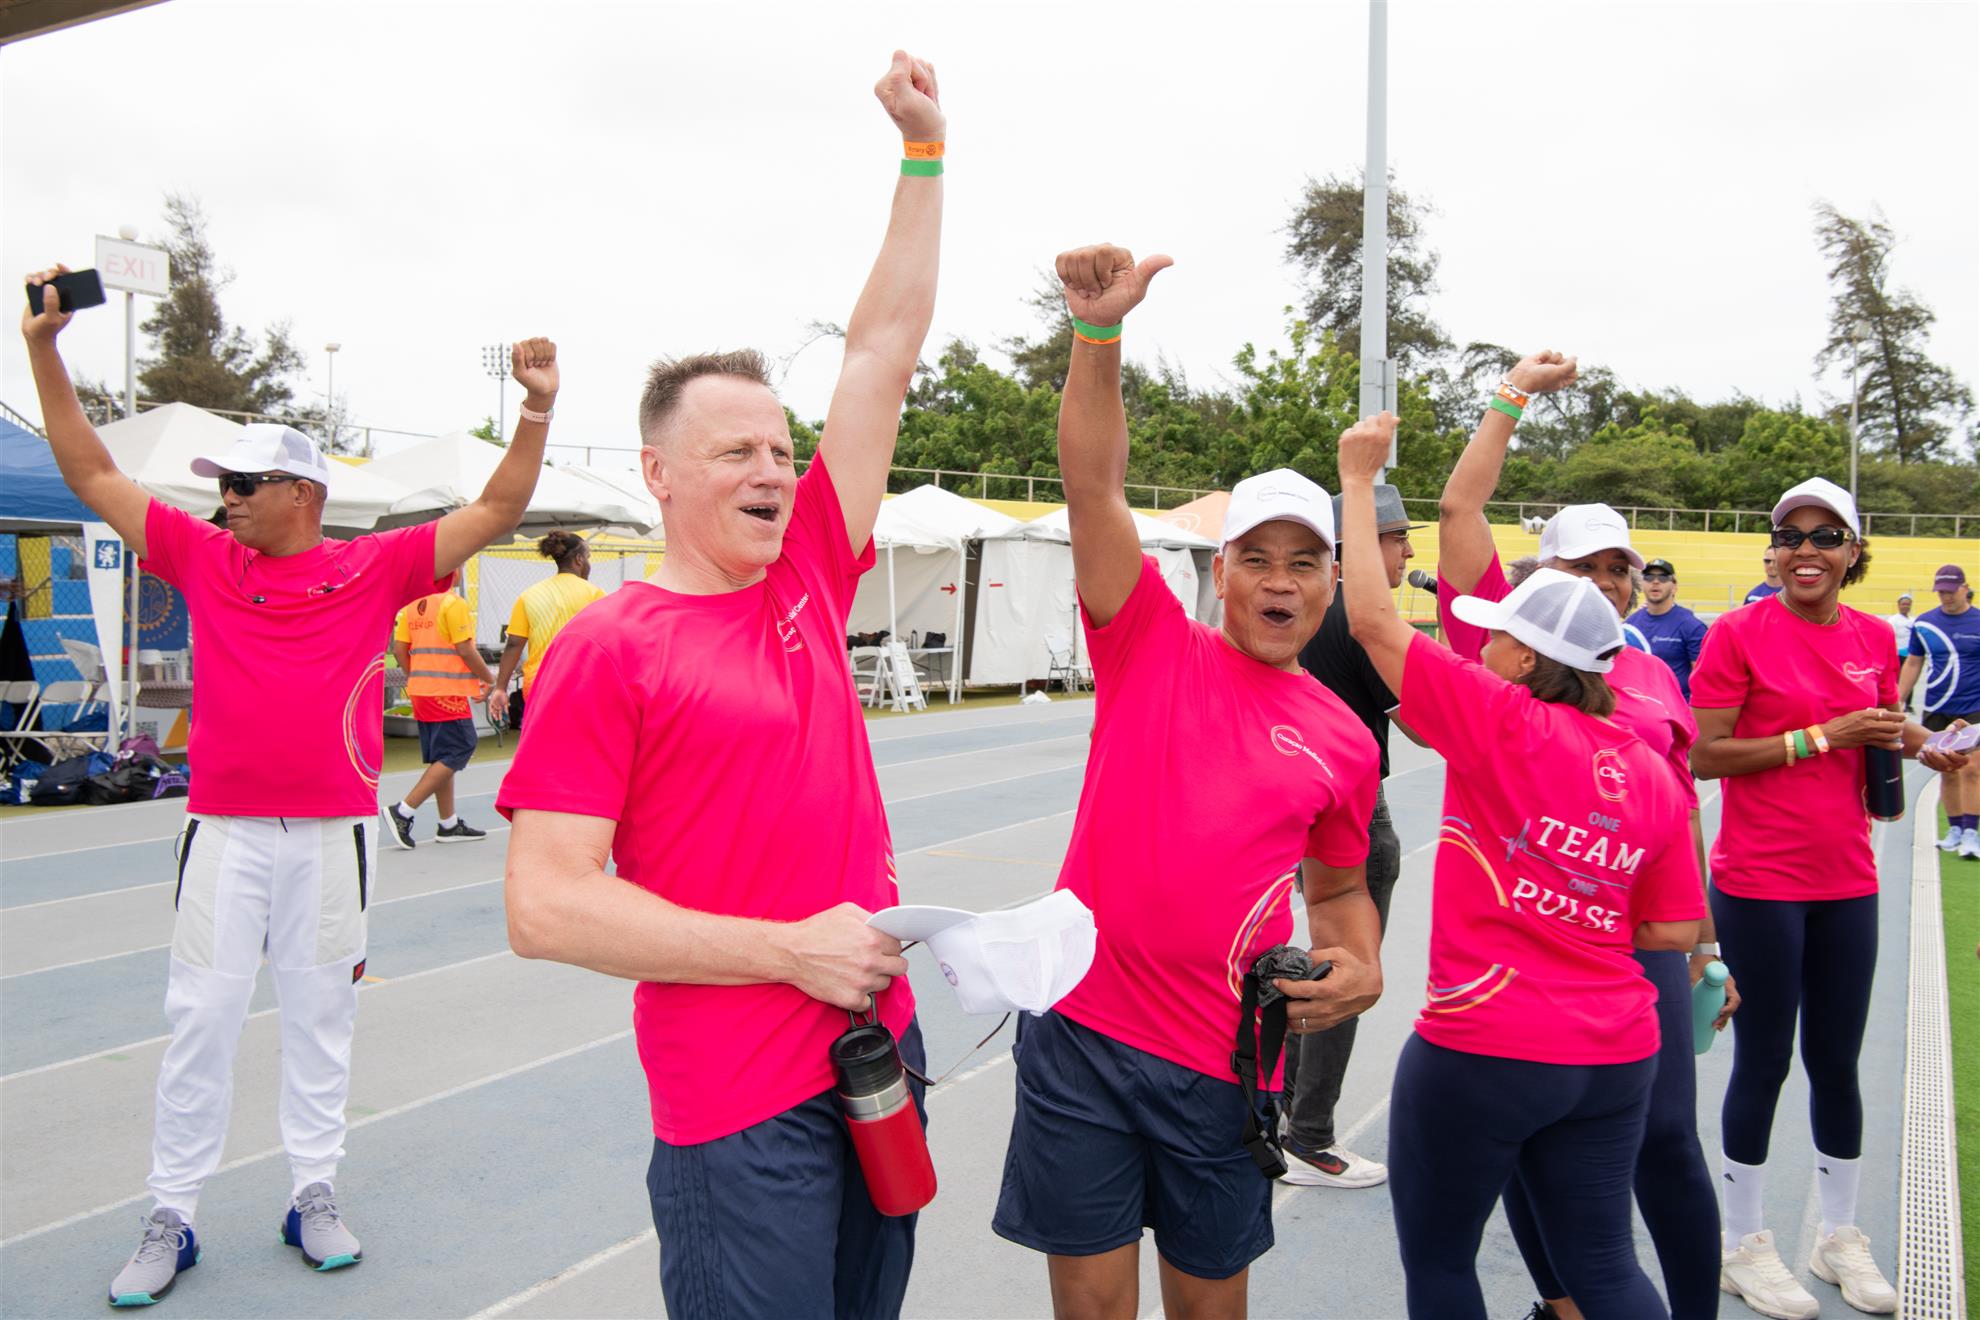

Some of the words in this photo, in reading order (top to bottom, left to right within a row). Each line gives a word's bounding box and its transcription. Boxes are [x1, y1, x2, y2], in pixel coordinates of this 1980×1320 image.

[105, 253, 157, 283] EXIT
[1588, 811, 1621, 833] ONE
[1536, 815, 1646, 875] TEAM
[1567, 878, 1599, 896] ONE
[1512, 877, 1623, 933] PULSE
